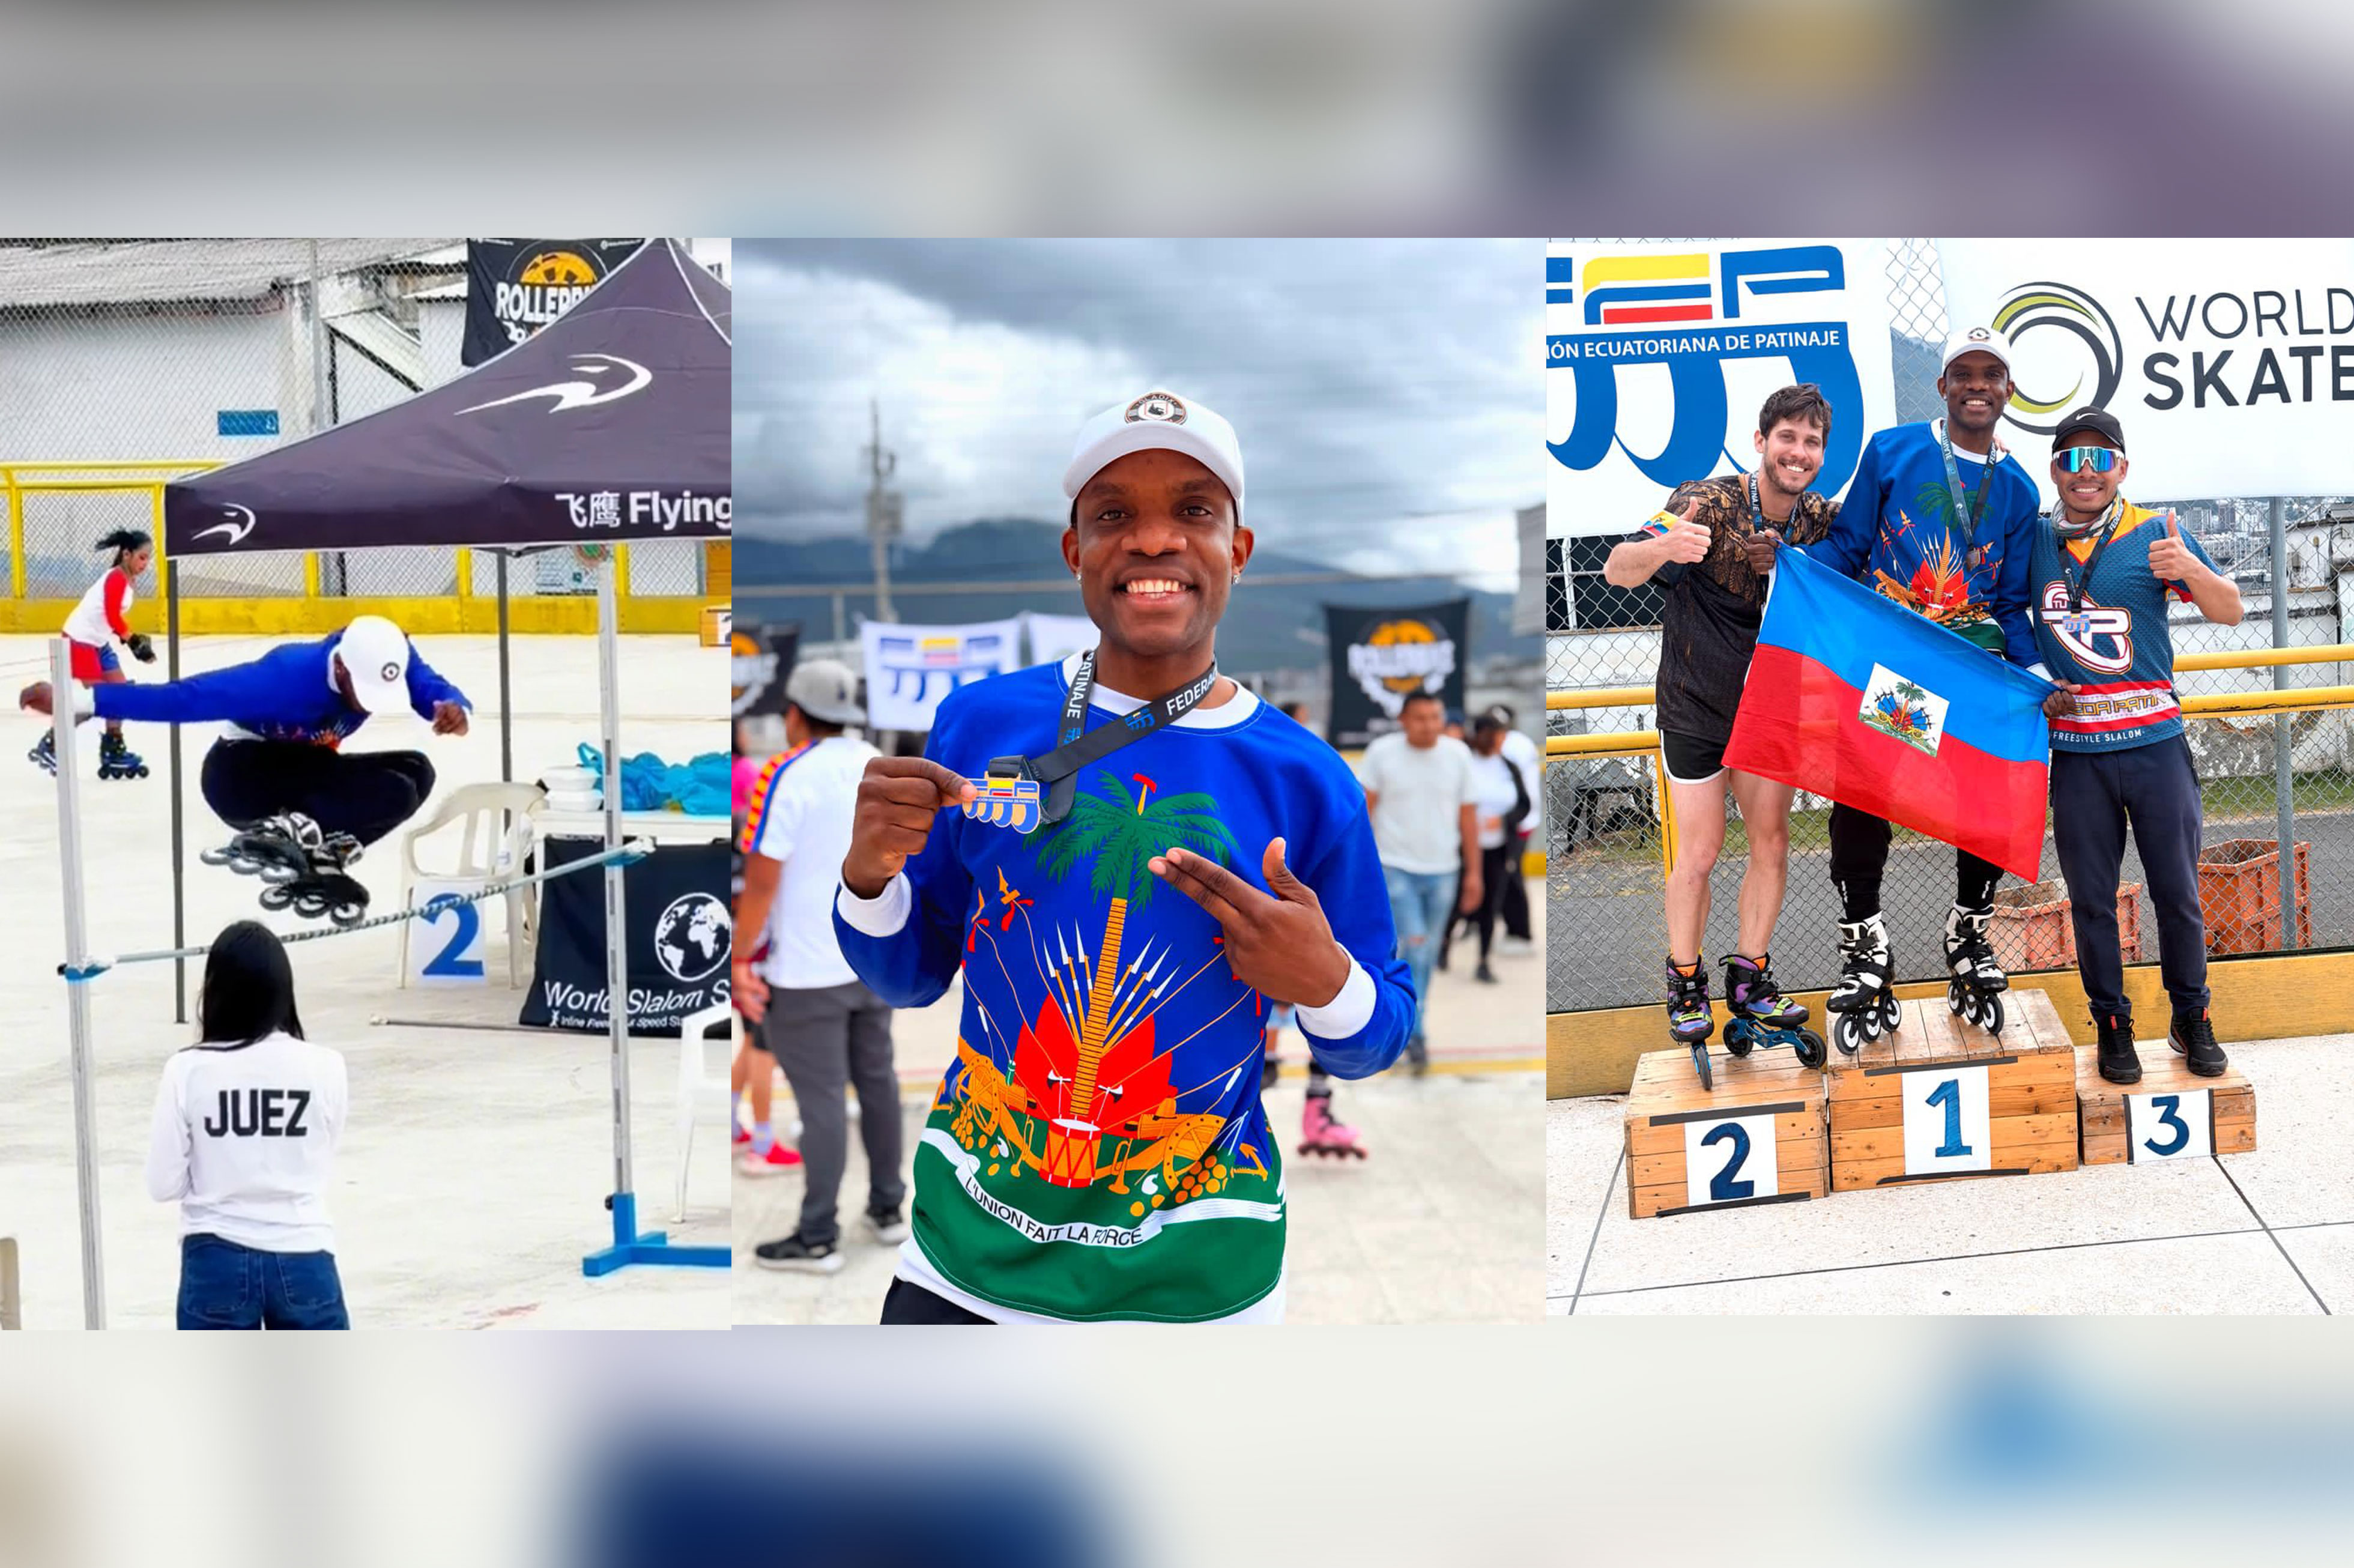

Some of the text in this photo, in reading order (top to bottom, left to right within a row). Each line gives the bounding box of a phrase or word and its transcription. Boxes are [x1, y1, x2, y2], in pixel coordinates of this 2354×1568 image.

[2135, 288, 2354, 342] WORLD
[1585, 336, 1720, 359] ECUATORIANA
[1725, 334, 1750, 351] DE
[1756, 330, 1839, 348] PATINAJE
[2143, 345, 2354, 411] SKATE
[555, 491, 620, 528] 飞鹰
[629, 490, 731, 531] Flying
[2053, 729, 2141, 743] FREESTYLE SLALOM
[422, 893, 483, 976] 2
[626, 988, 702, 1014] Slalom
[204, 1089, 310, 1137] JUEZ
[1925, 1079, 1972, 1158] 1
[2144, 1095, 2189, 1156] 3
[1701, 1122, 1754, 1200] 2
[965, 1176, 1143, 1246] L'UNION FAIT LA FORCE
